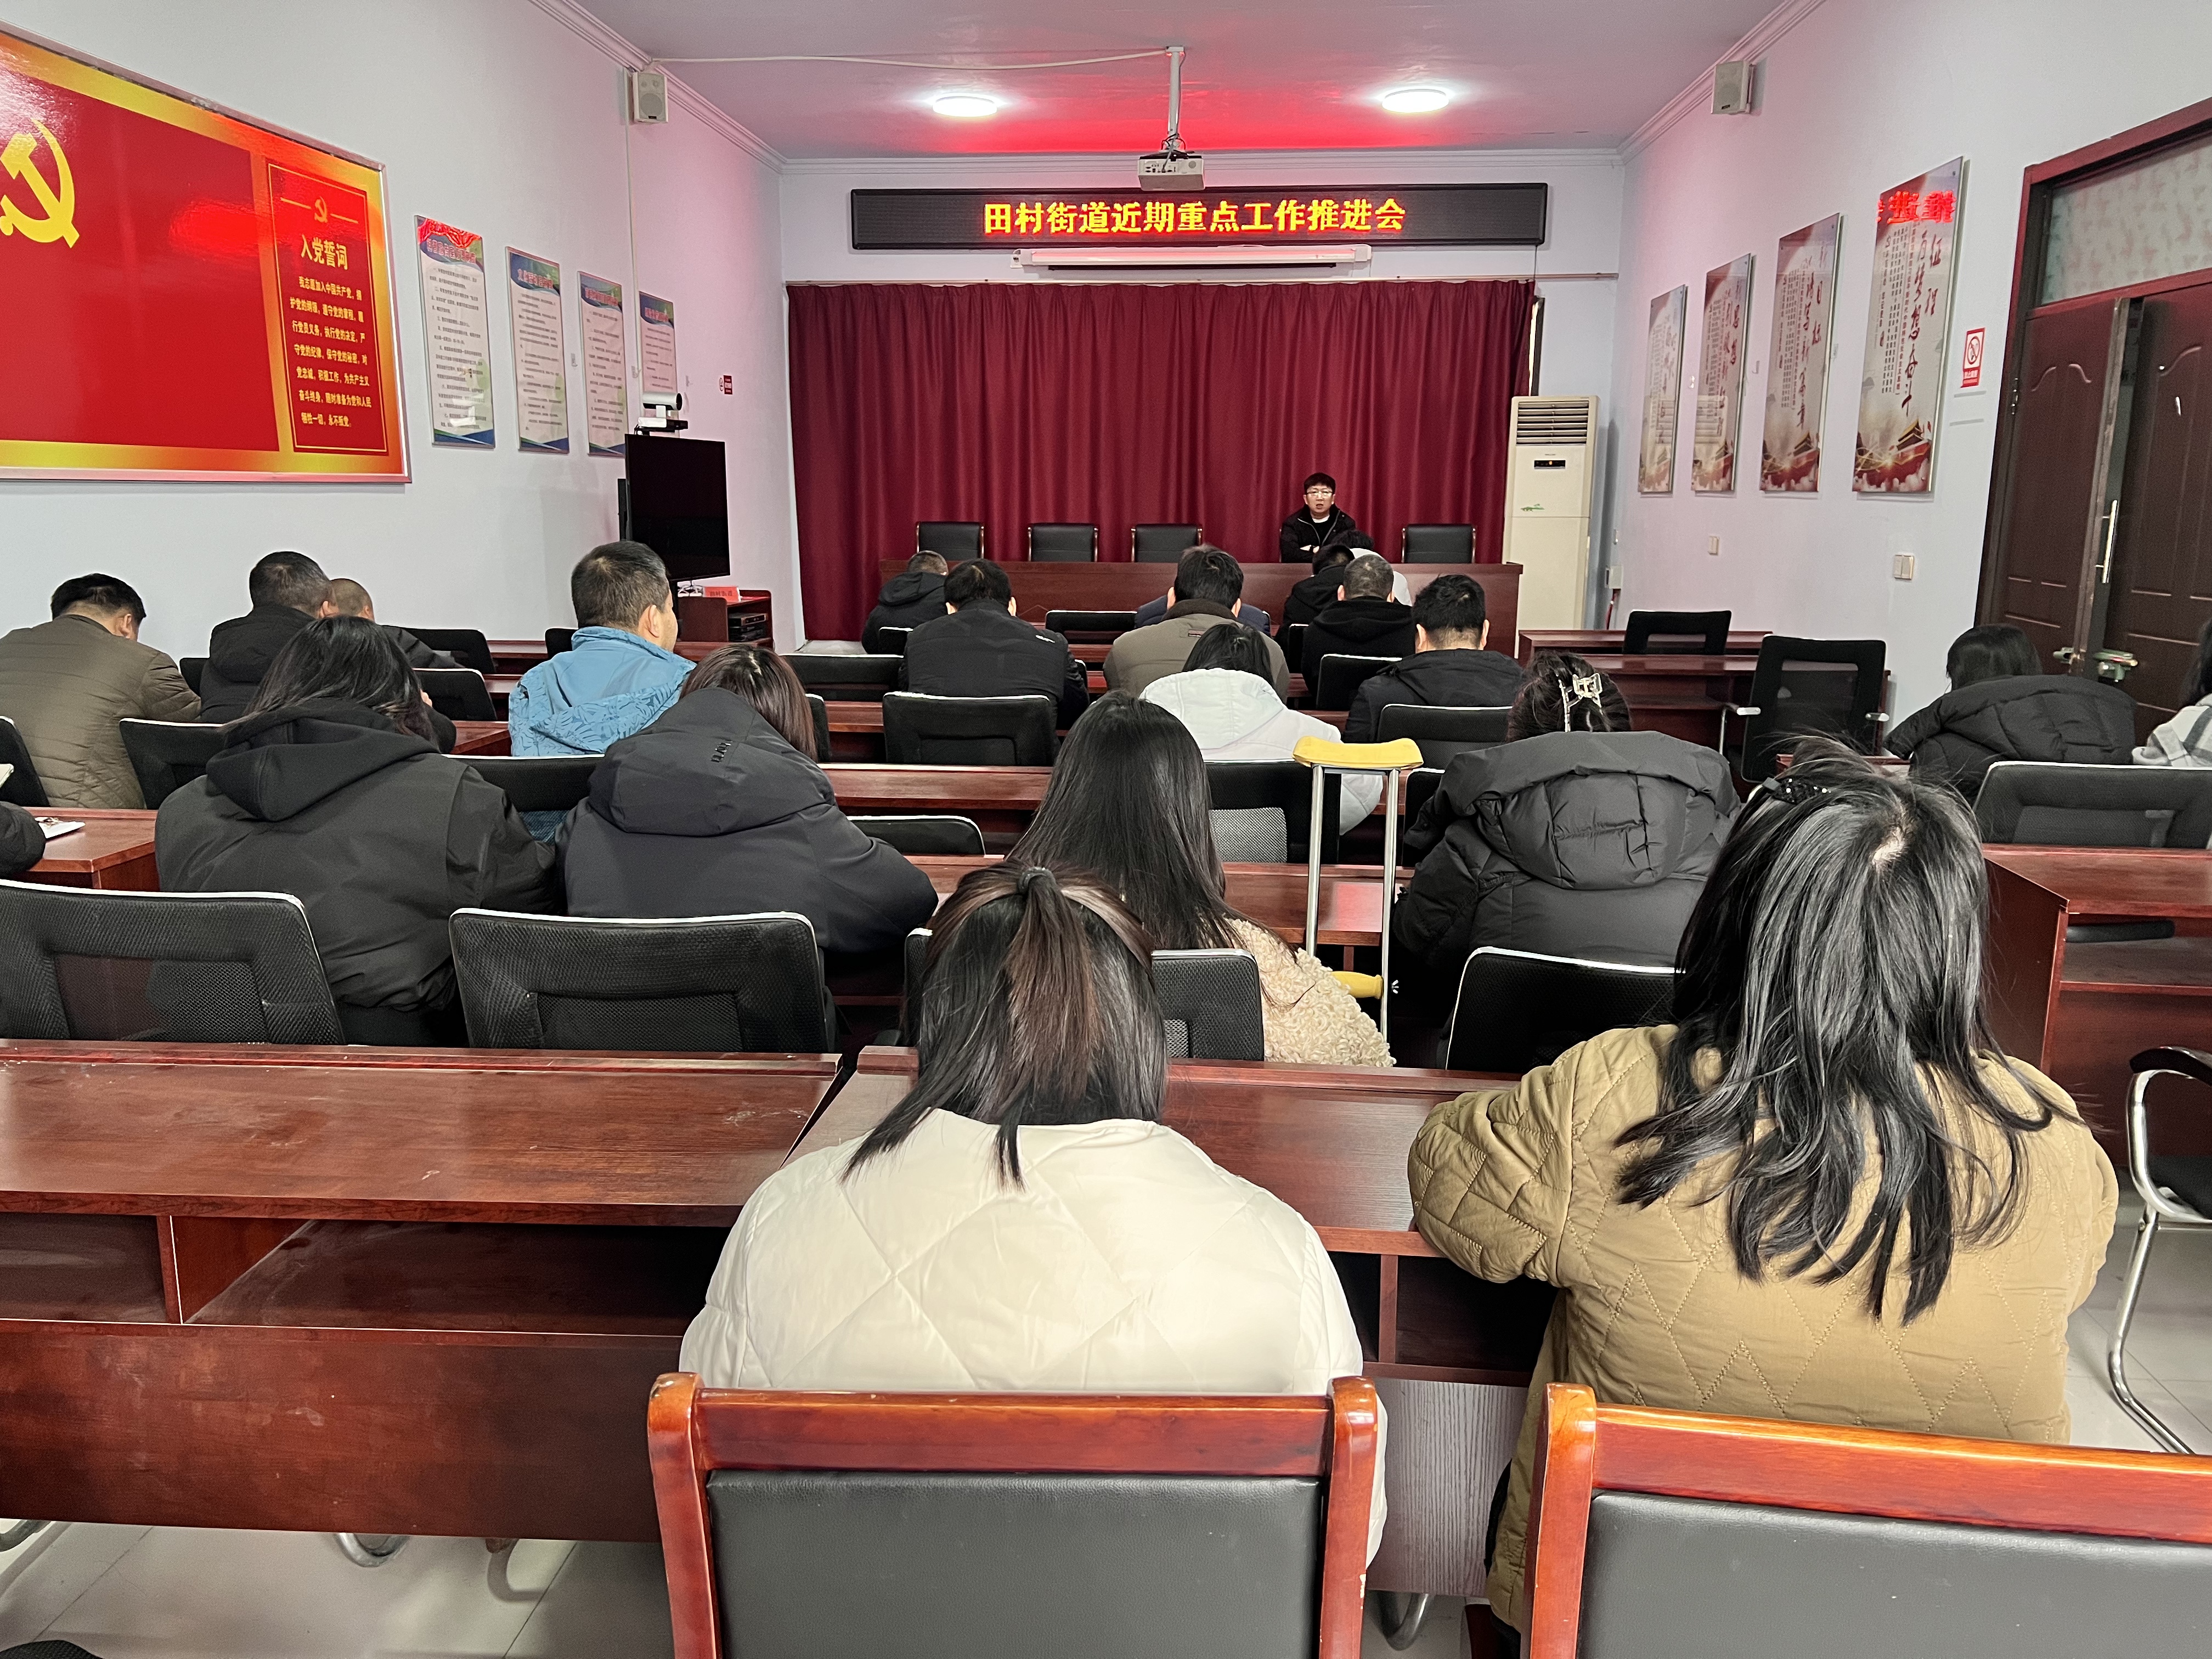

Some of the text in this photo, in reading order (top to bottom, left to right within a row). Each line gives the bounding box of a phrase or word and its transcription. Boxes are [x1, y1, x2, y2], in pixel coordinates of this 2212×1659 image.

[984, 198, 1406, 234] 田村街道近期重点工作推进会
[301, 234, 348, 270] 入党誓词
